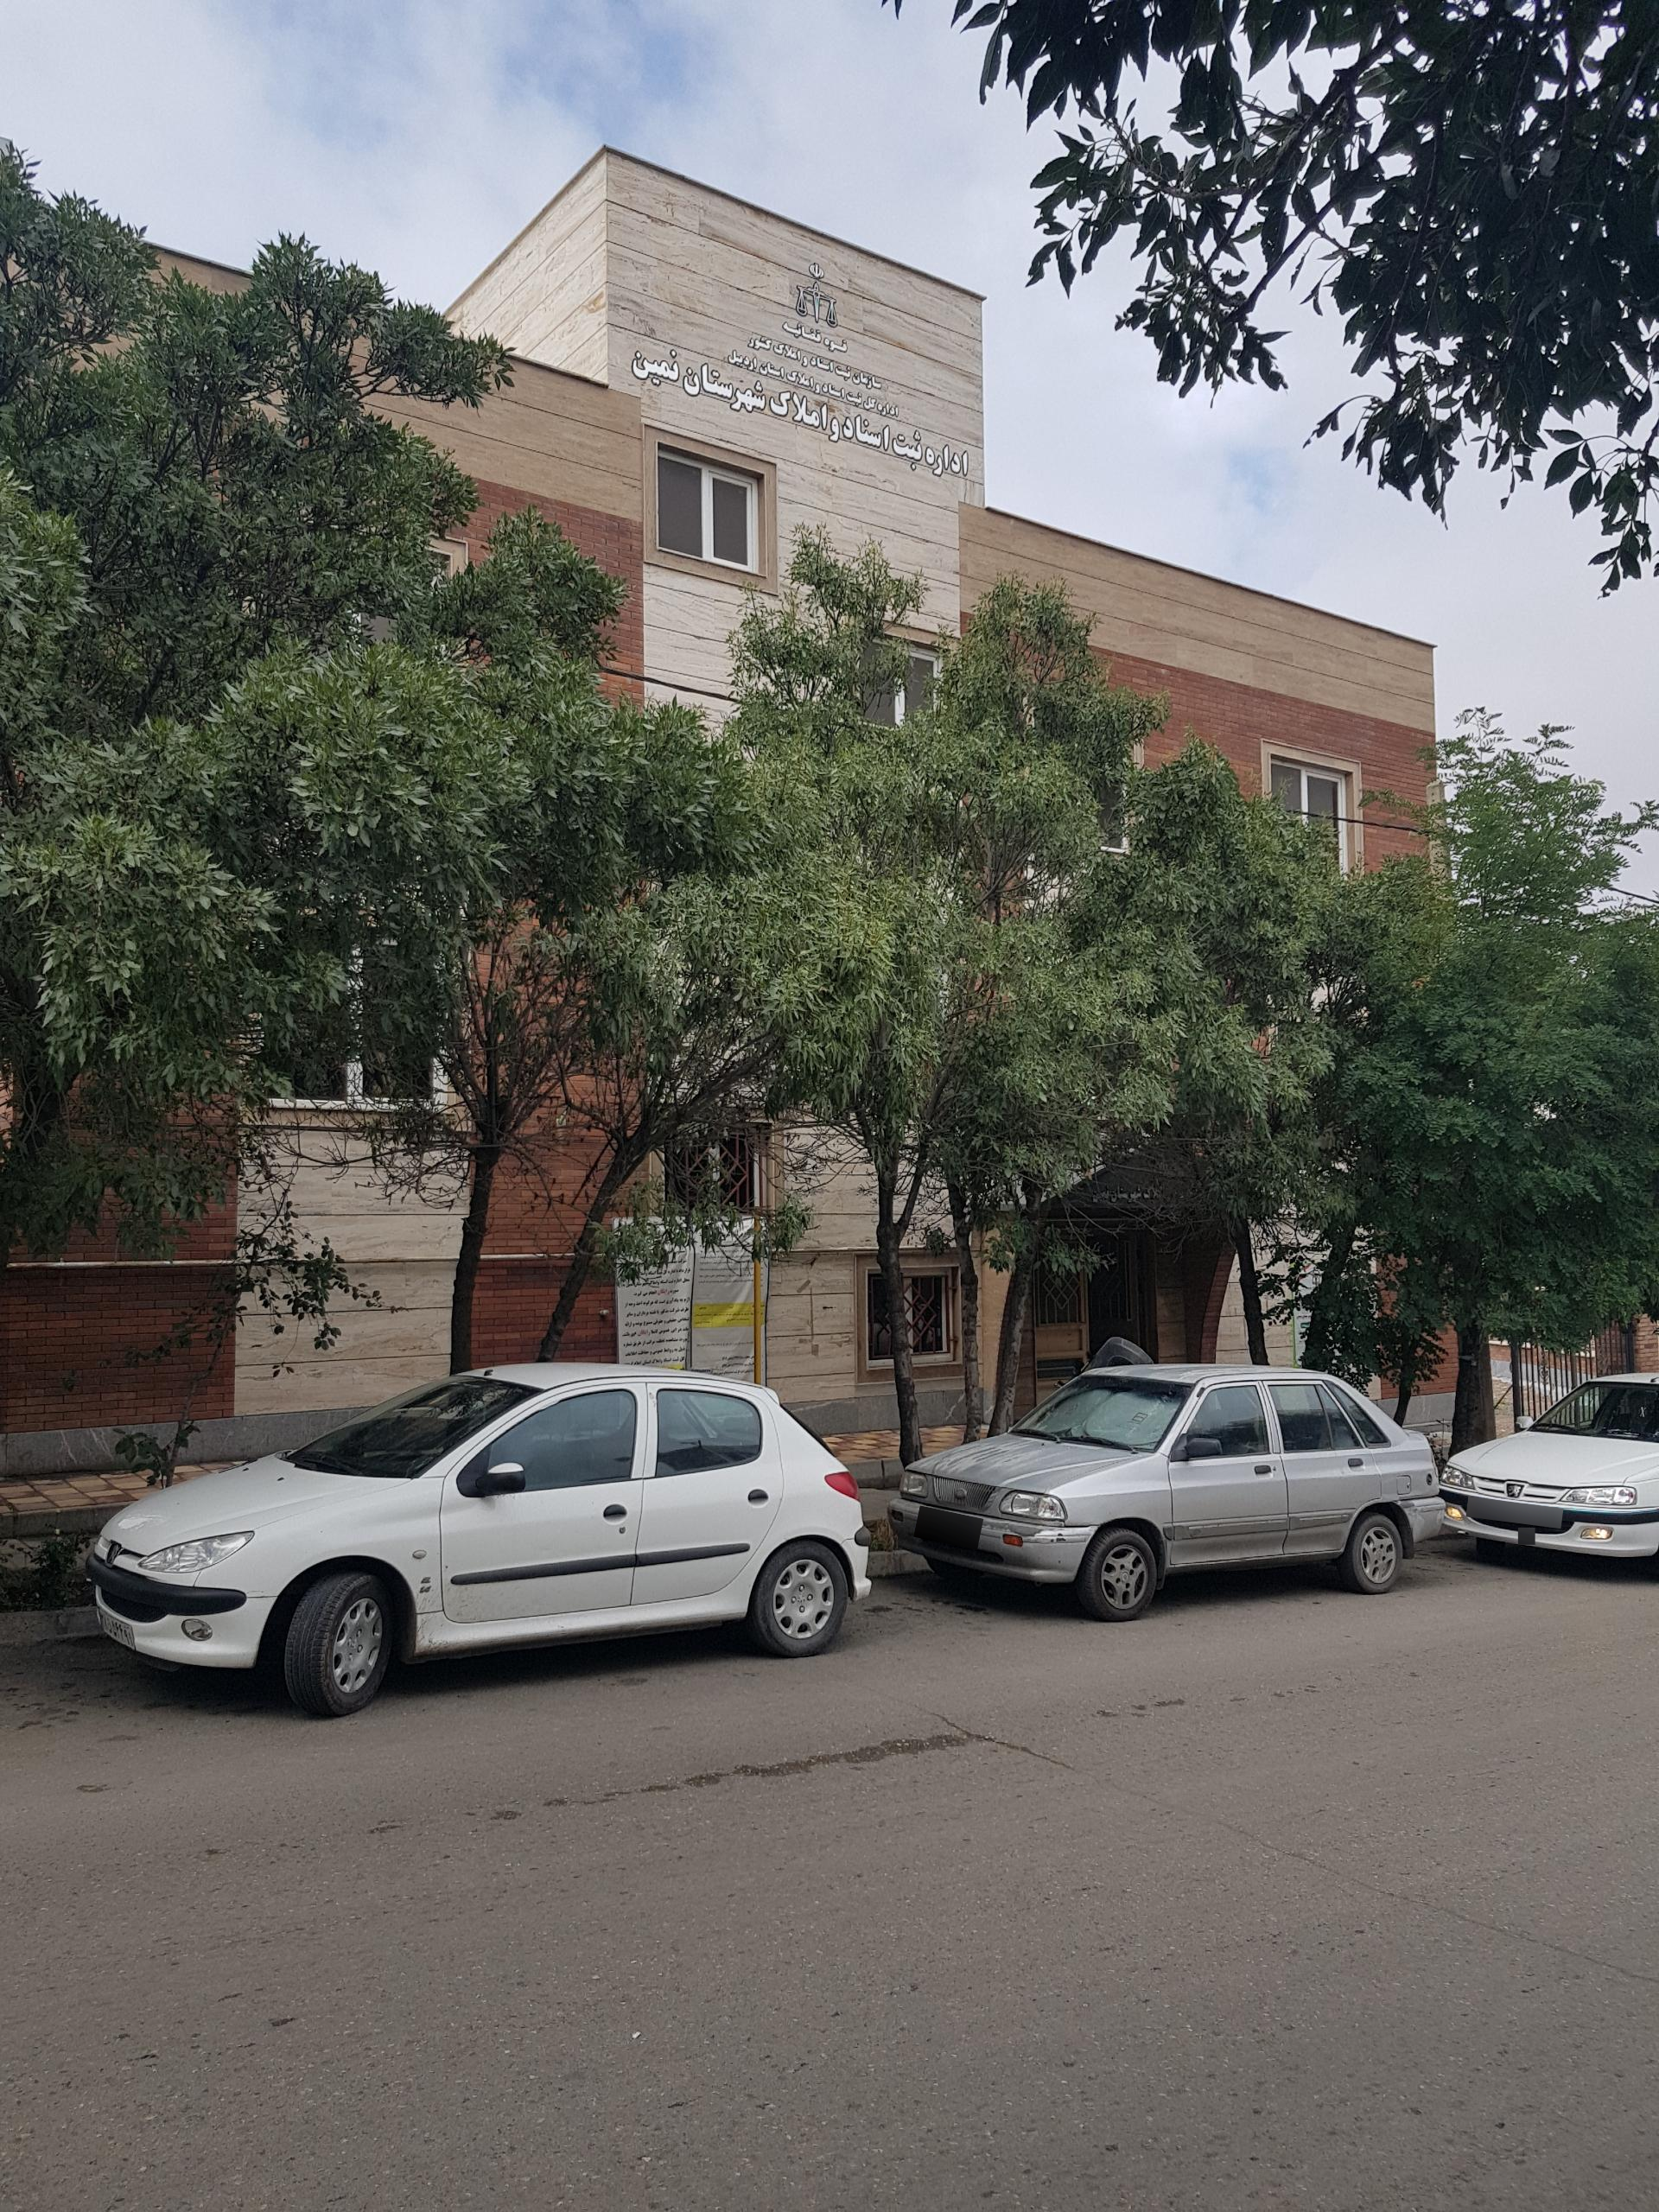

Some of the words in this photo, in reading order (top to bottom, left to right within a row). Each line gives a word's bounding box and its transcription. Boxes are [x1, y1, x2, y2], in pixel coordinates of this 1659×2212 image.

[747, 336, 772, 351] کشور
[823, 339, 848, 353] قوه
[728, 350, 757, 371] اردبیل
[773, 344, 801, 361] املاک
[632, 350, 679, 386] نمین
[759, 362, 785, 378] استان
[802, 357, 808, 366] و
[810, 355, 834, 372] اسناد
[786, 371, 814, 388] املاک
[836, 365, 851, 380] ثبت
[853, 372, 881, 389] سازمان
[683, 363, 766, 413] شهرستان
[814, 383, 821, 394] و
[822, 383, 845, 398] اسناد
[846, 391, 862, 404] ثبت
[863, 397, 876, 410] کل
[770, 391, 828, 430] املاک
[877, 404, 899, 417] اداره
[829, 416, 840, 443] و
[842, 414, 890, 451] اسناد
[892, 429, 923, 471] ثبت
[925, 444, 969, 477] اداره
